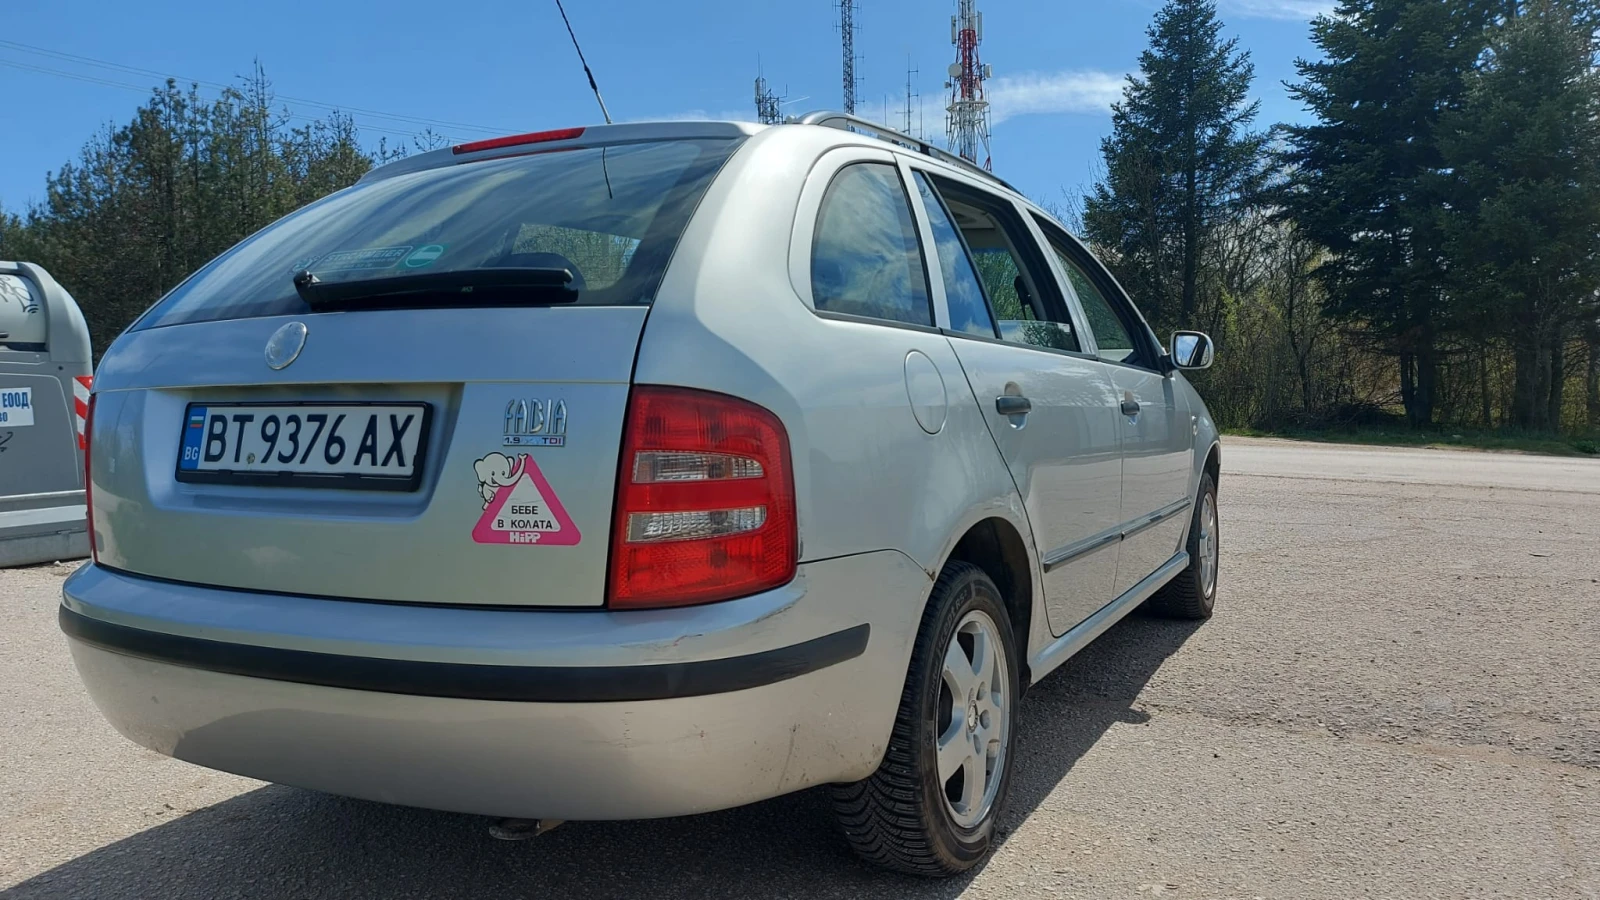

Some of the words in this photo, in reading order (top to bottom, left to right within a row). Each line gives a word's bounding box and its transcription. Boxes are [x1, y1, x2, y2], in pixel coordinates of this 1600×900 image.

[2, 392, 29, 409] ЕООД
[504, 399, 567, 433] FABIA
[204, 415, 254, 463] BT
[260, 415, 347, 465] 9376
[354, 415, 415, 467] AX
[184, 446, 199, 461] BG
[511, 505, 538, 515] БЕБЕ
[497, 520, 504, 528] В
[511, 520, 553, 529] КОЛАТА
